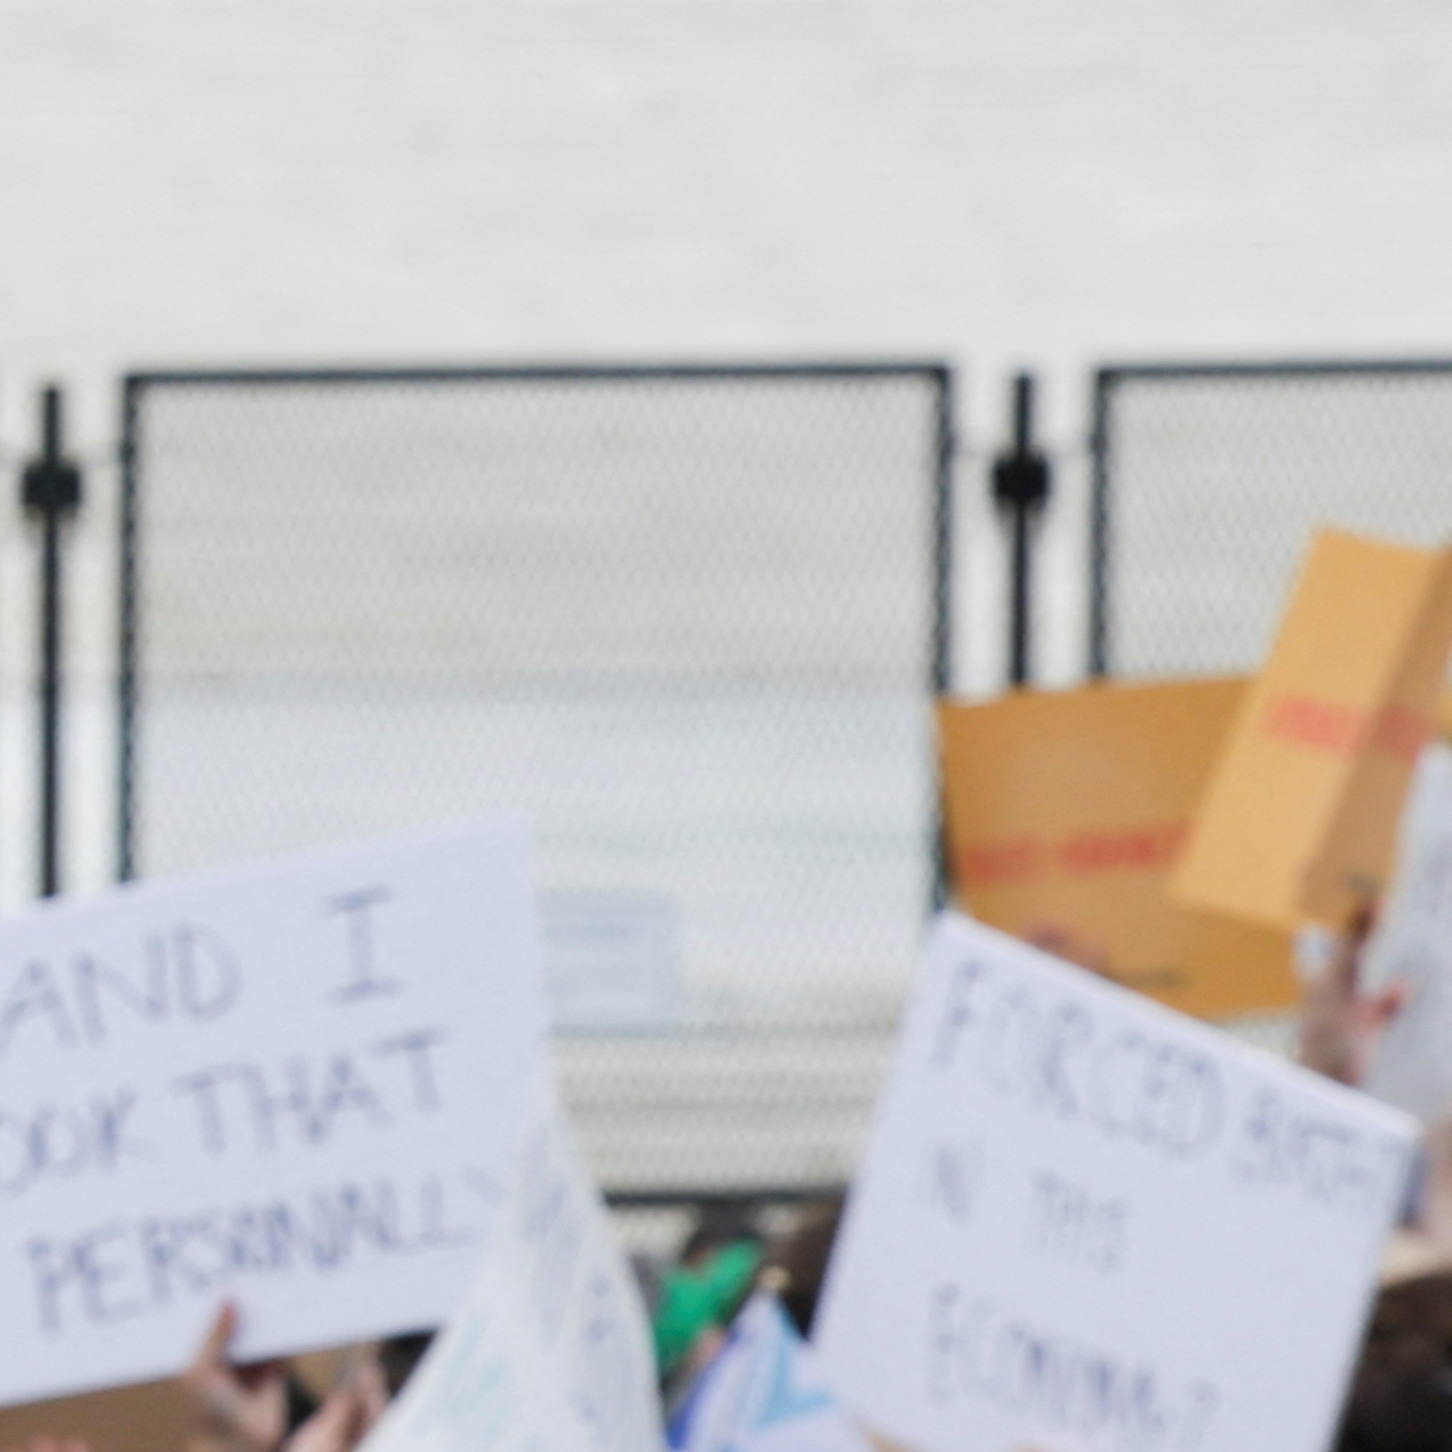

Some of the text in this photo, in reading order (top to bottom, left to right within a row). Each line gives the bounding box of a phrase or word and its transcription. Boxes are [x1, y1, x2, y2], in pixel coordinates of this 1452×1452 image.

[323, 884, 406, 1009] I
[170, 1025, 448, 1157] THAT
[928, 955, 1228, 1164] FORCED
